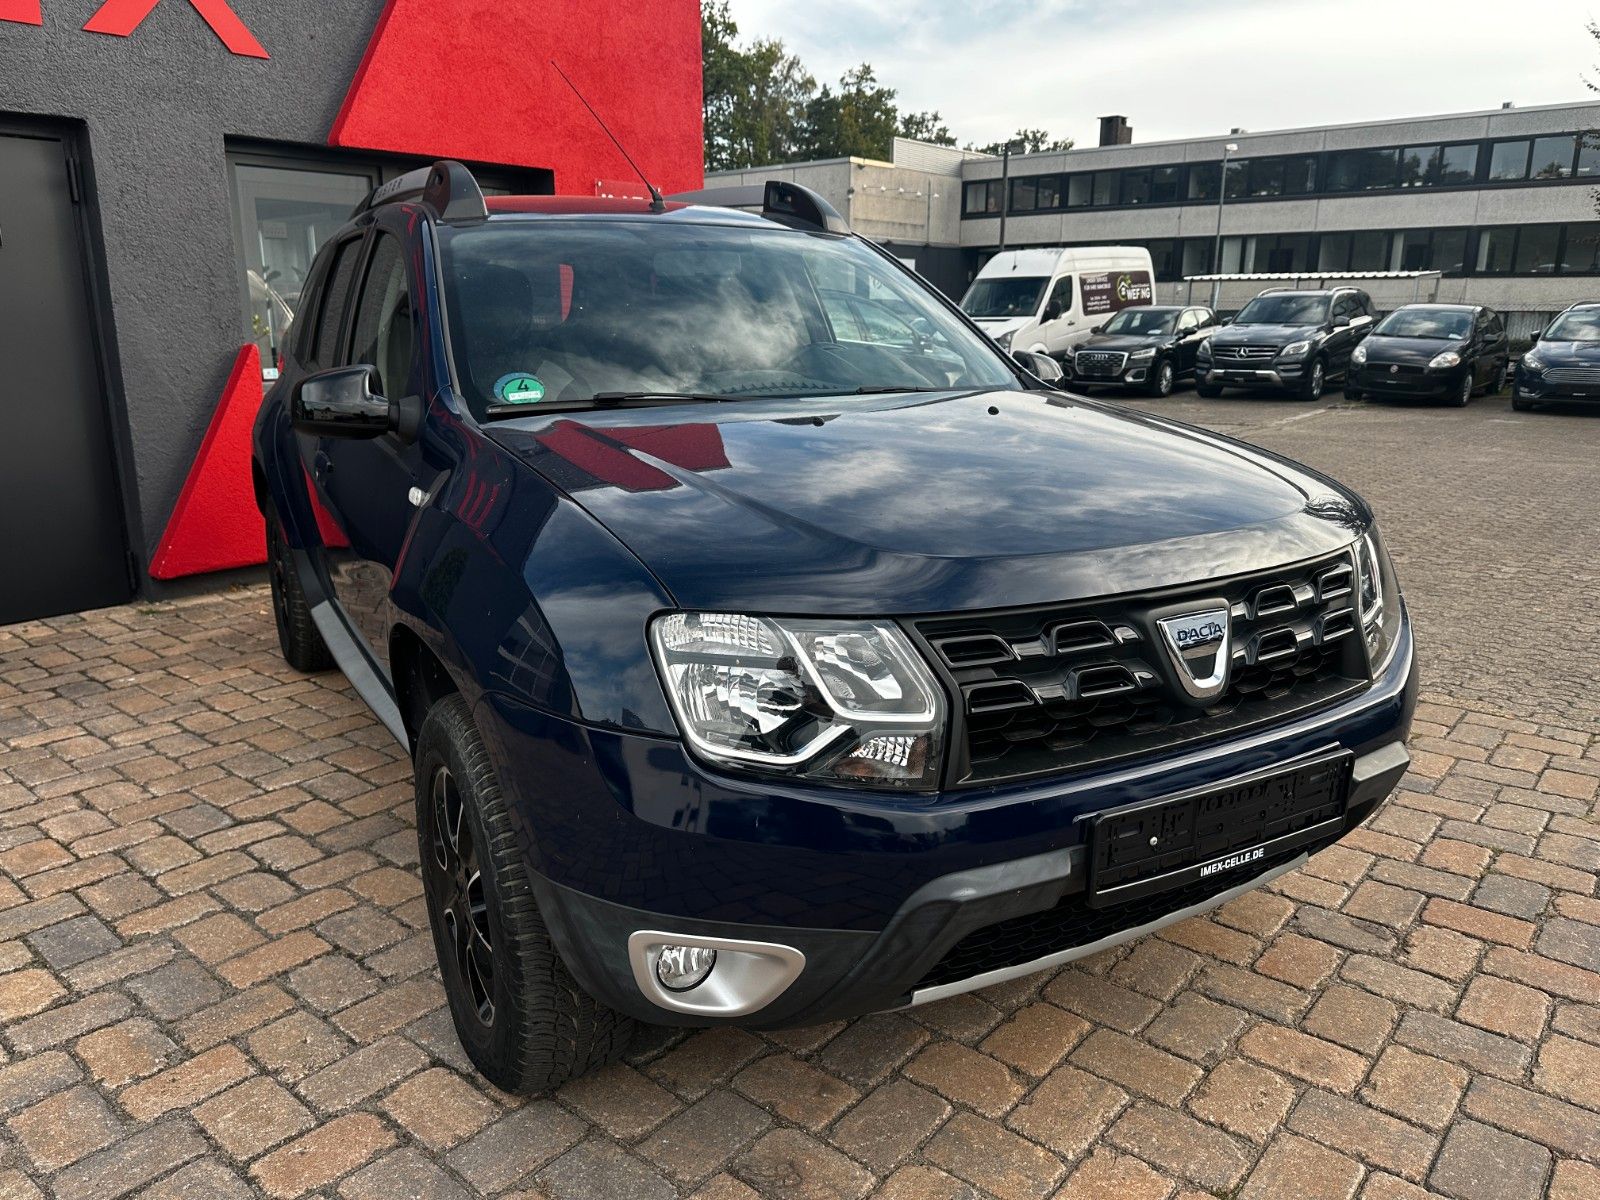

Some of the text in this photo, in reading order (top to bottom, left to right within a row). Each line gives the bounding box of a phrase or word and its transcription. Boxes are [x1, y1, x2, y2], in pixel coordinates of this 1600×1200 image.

[517, 379, 529, 391] 4
[1177, 622, 1223, 641] DACIA
[1200, 847, 1265, 877] IMEX-CELLE.DE
